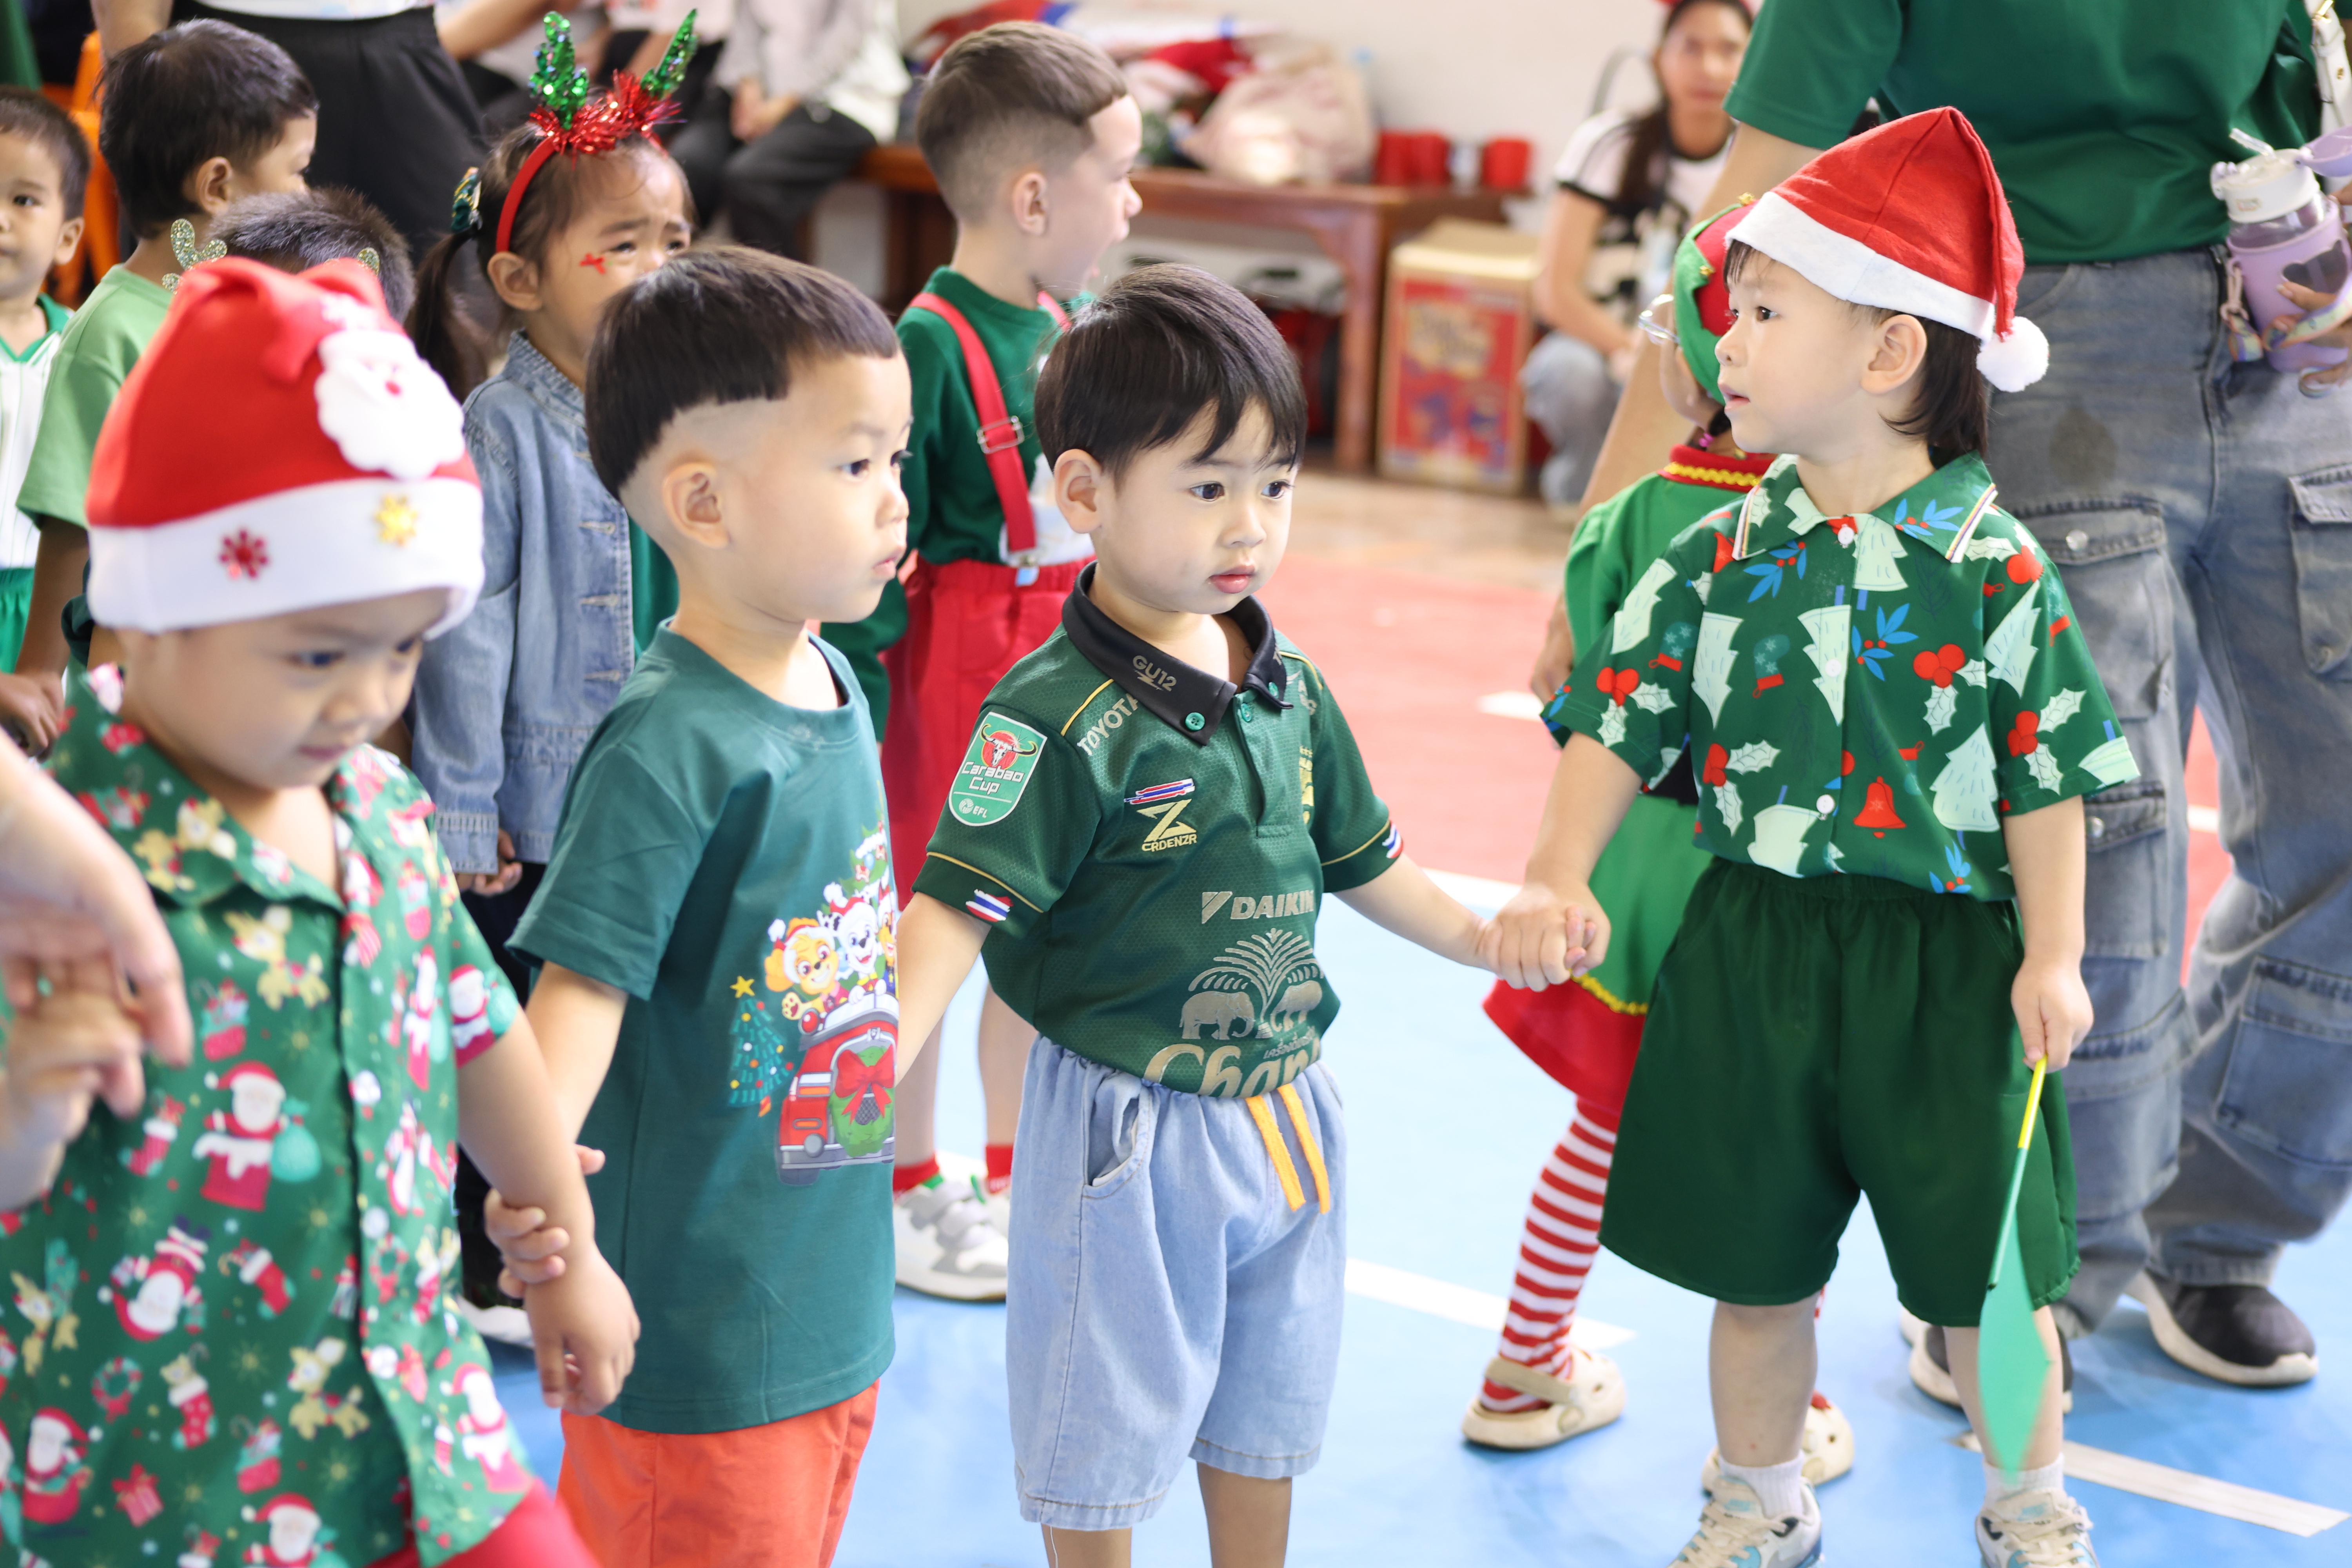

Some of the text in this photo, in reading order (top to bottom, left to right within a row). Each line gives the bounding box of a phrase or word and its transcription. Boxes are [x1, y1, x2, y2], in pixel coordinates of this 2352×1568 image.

[1132, 655, 1176, 691] GU12
[961, 761, 1025, 782] Carabao
[969, 776, 1001, 795] Cup
[972, 806, 988, 818] EFL
[1144, 1038, 1320, 1098] Chan
